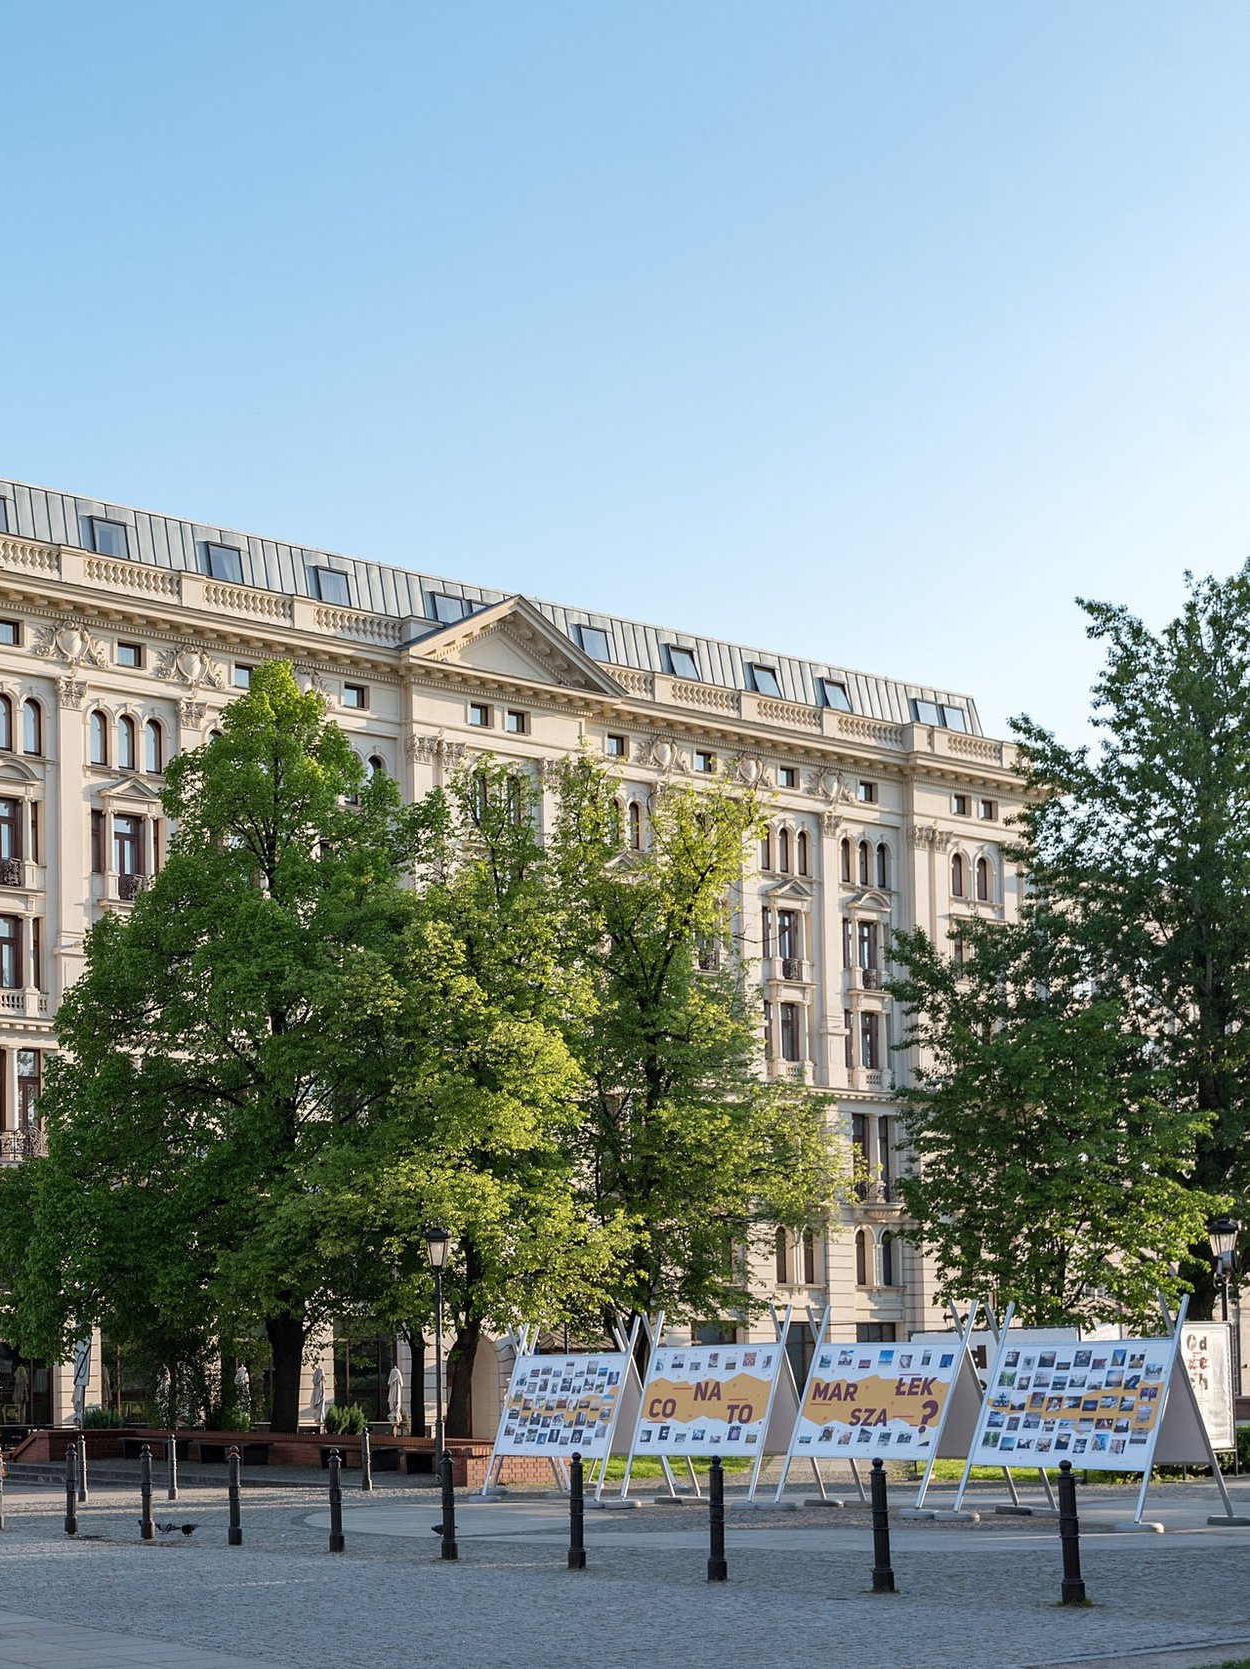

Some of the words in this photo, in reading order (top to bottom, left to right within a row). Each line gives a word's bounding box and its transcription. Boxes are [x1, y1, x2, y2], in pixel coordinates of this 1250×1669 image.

[648, 1398, 677, 1418] CO
[693, 1381, 722, 1401] NA
[726, 1404, 753, 1424] TO
[811, 1382, 858, 1401] MAR
[848, 1408, 888, 1427] SZA
[895, 1377, 938, 1396] ŁEK
